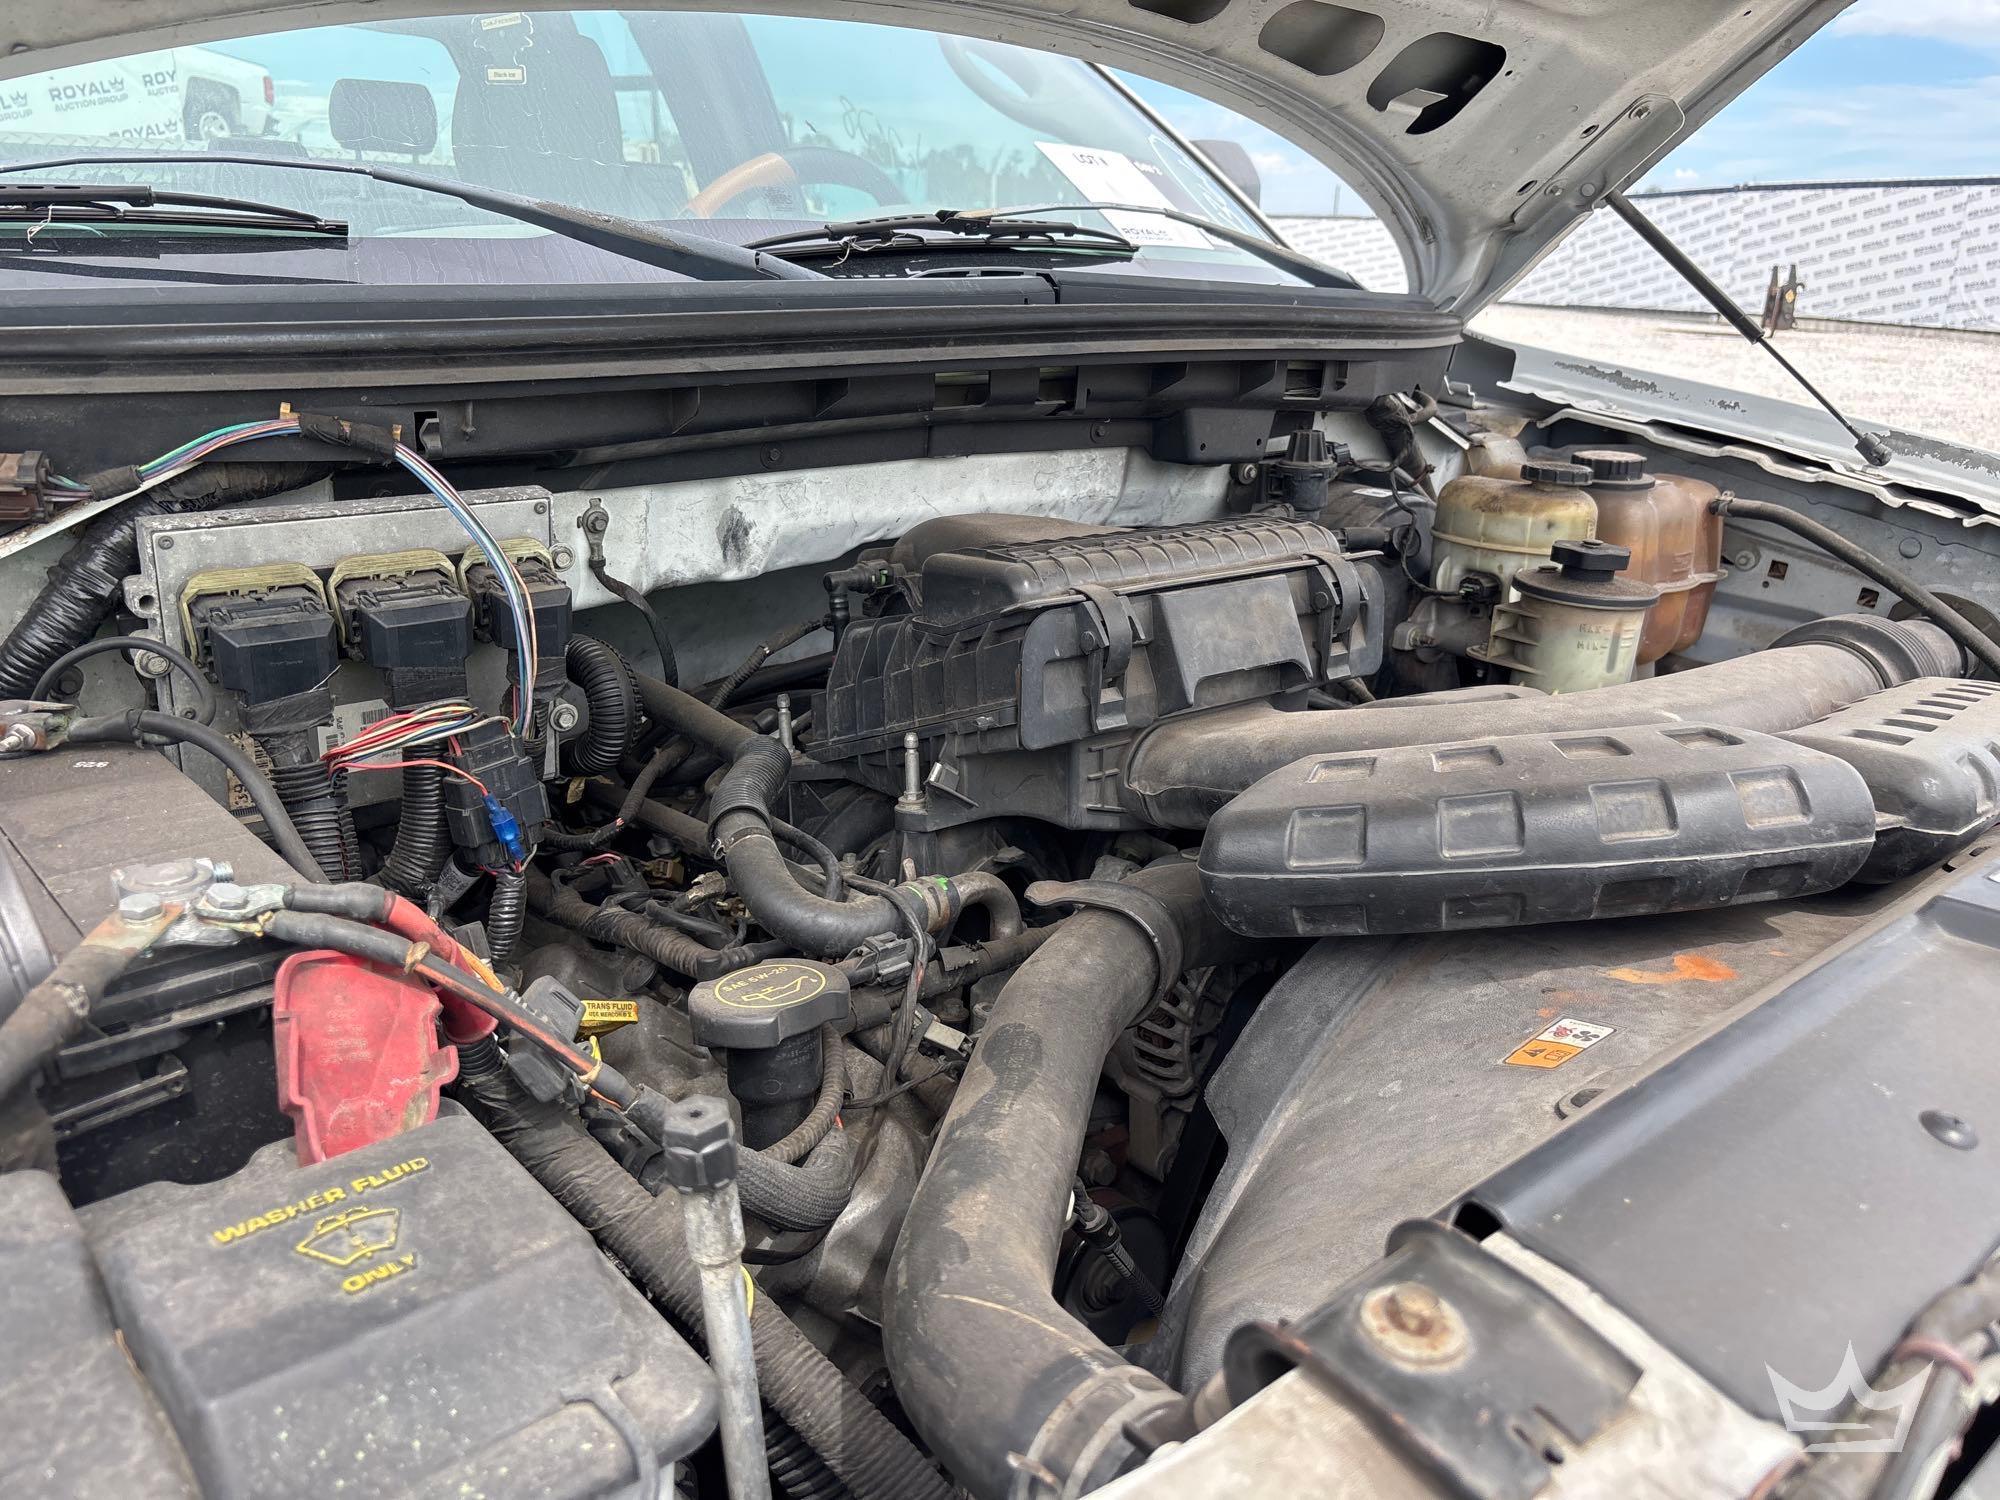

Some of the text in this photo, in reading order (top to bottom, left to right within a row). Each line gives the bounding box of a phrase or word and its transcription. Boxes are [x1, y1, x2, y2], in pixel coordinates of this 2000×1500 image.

[142, 70, 177, 88] ROY
[49, 80, 111, 102] ROYAL
[147, 85, 179, 97] AUCTIO
[54, 93, 129, 113] AUCTION GROUP
[1121, 227, 1160, 236] ROYAL
[722, 980, 750, 992] SAE
[586, 1002, 633, 1011] TRANS FLUID
[213, 1157, 429, 1243] WASHER FLUID
[342, 1253, 416, 1293] ONLY
